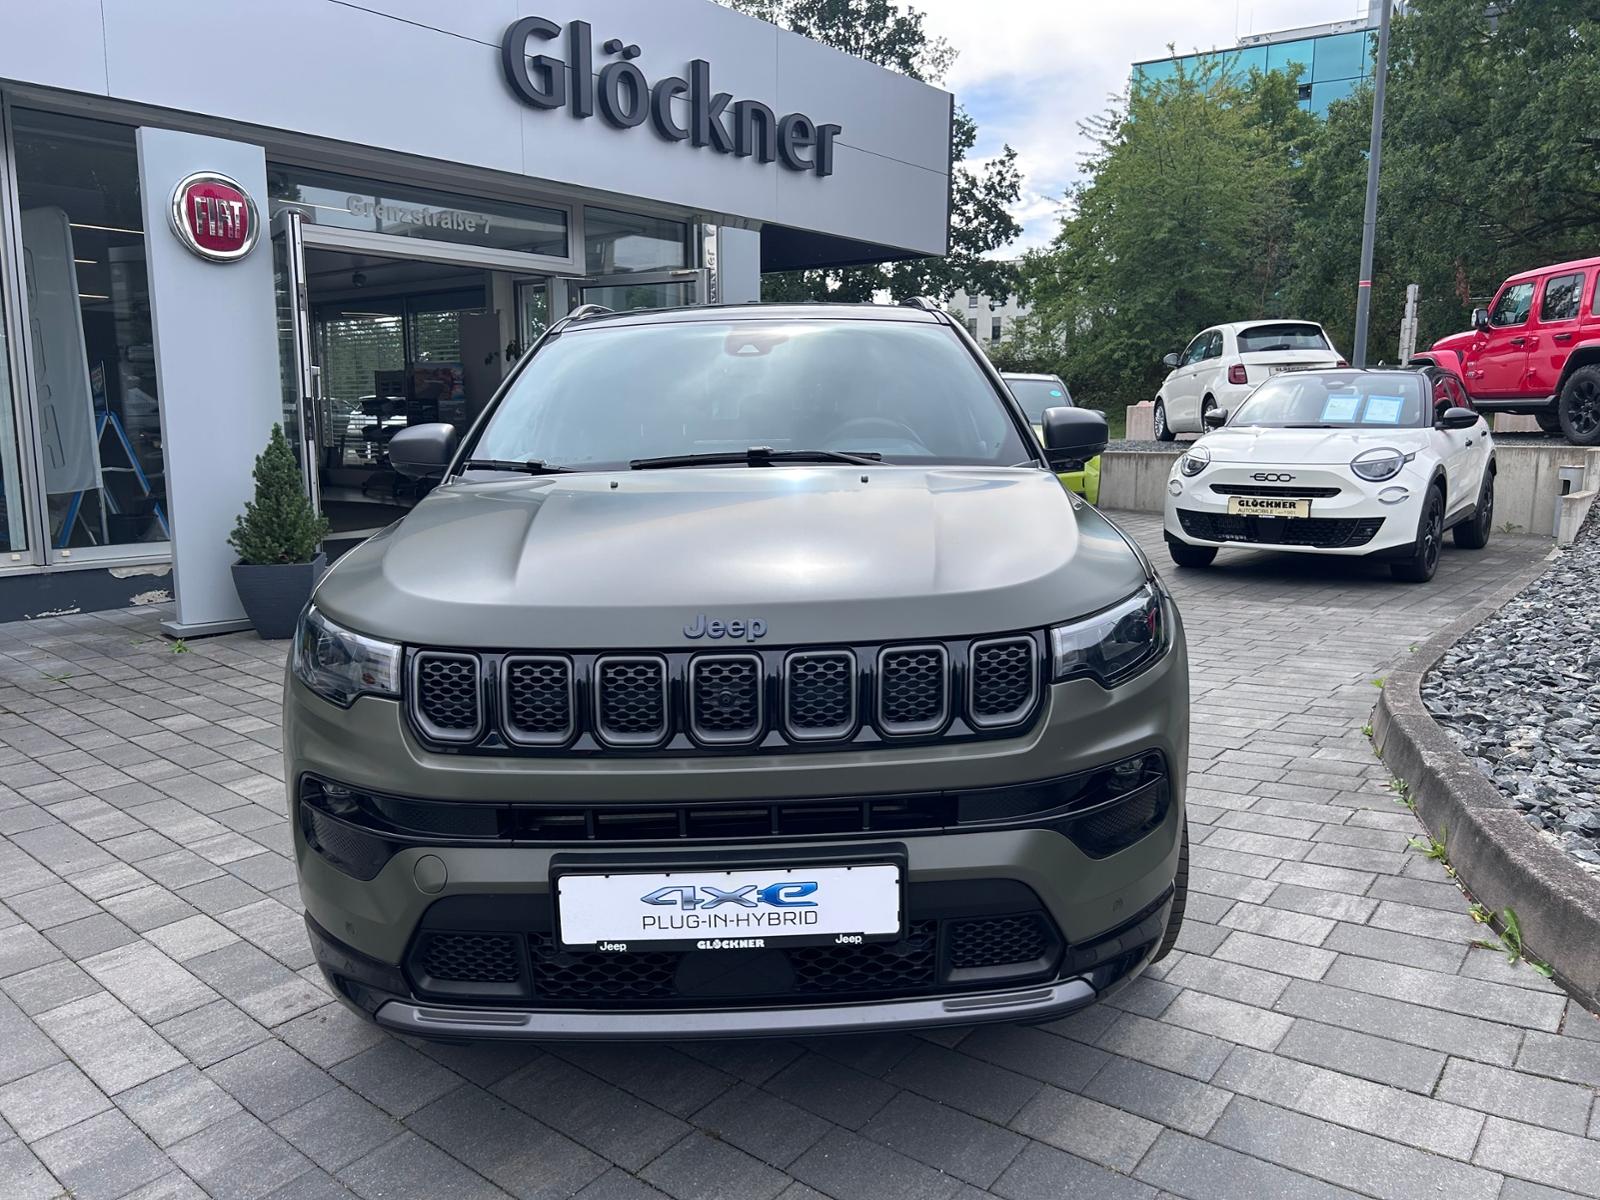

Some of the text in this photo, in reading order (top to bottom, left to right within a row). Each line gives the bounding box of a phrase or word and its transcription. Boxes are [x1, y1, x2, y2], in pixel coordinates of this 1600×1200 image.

[501, 16, 842, 176] Glöckner
[194, 195, 243, 238] FIAT
[346, 195, 490, 234] Grenzstraße 7
[1252, 473, 1293, 482] 600
[1238, 499, 1297, 509] GLÖCKNER
[683, 613, 767, 642] Jeep
[642, 910, 818, 930] PLUG-IN-HYBRID
[600, 941, 627, 952] Jeep
[835, 933, 862, 945] Jeep
